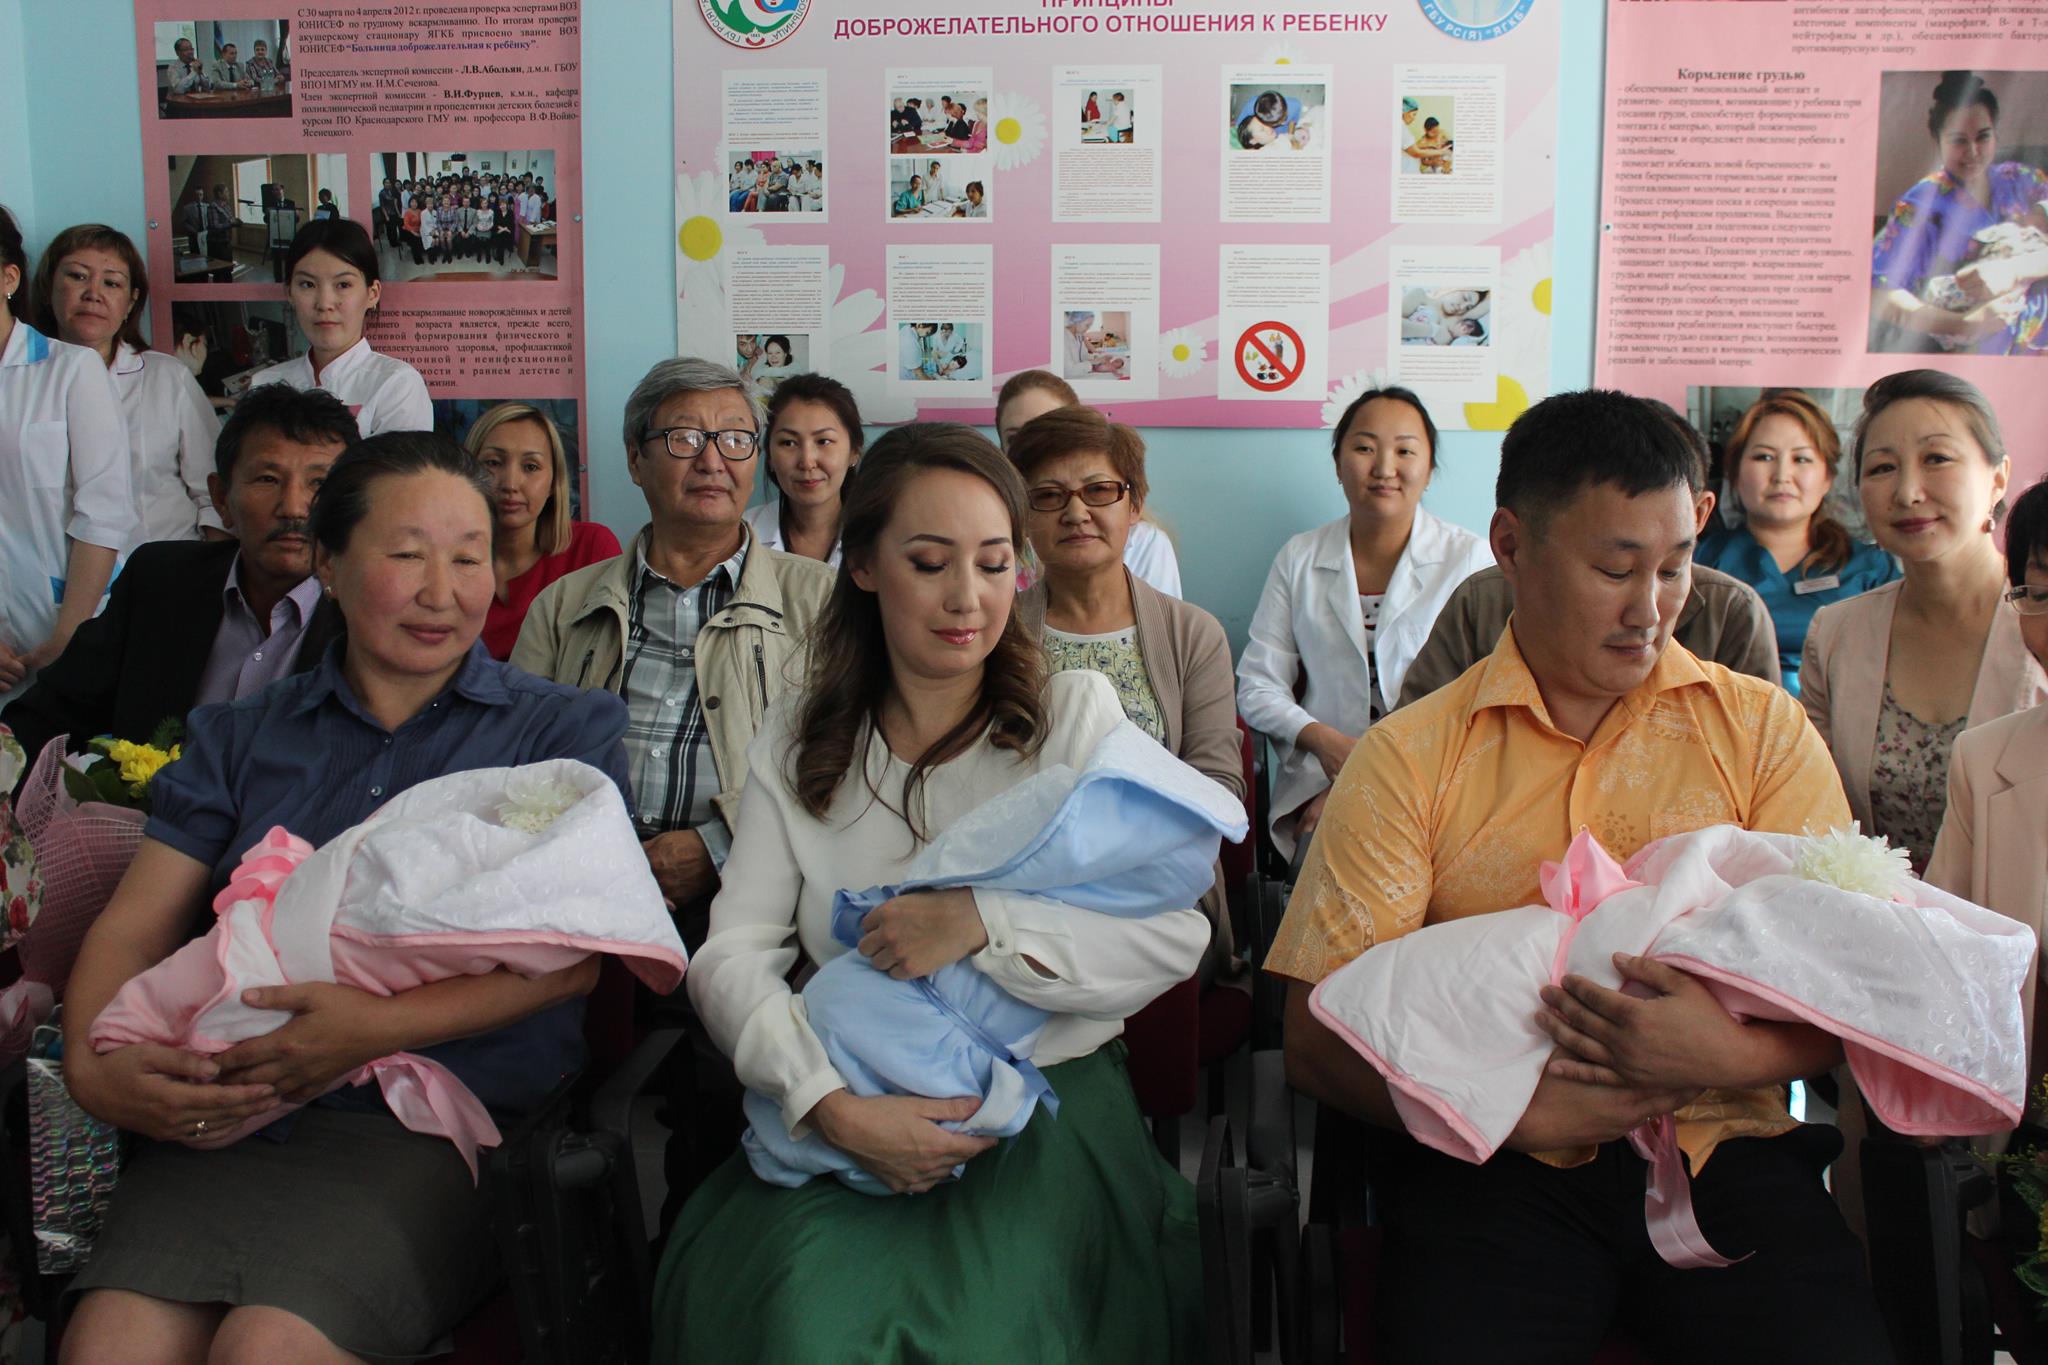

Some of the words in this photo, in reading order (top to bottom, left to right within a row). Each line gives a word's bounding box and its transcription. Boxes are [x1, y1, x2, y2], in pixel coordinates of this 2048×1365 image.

[298, 9, 304, 18] С
[307, 8, 316, 17] 30
[318, 10, 342, 18] марта
[362, 8, 392, 17] апреля
[394, 7, 414, 15] 2012
[423, 6, 468, 16] проведена
[470, 6, 510, 14] проверка
[514, 5, 558, 14] эспертами
[559, 2, 577, 11] ВОЗ
[299, 20, 344, 29] ЮНИСЕФ
[364, 21, 403, 30] грудному
[409, 19, 479, 28] вскармливанию.
[485, 17, 498, 25] По
[538, 16, 577, 26] проверки
[834, 16, 1098, 40] ДОБРОЖЕЛАТЕЛЬНОГО
[1106, 14, 1254, 32] ОТНОШЕНИЯ
[1263, 14, 1276, 31] К
[1283, 14, 1388, 31] РЕБЕНКУ
[299, 34, 358, 43] акушерскому
[366, 32, 419, 41] стационару
[428, 30, 454, 38] ЯГКБ
[462, 30, 512, 39] присвоено
[559, 26, 577, 35] ВОЗ
[300, 44, 345, 53] ЮНИСЕФ
[398, 43, 483, 53] доброжелательная
[1678, 68, 1753, 83] Кормление
[1757, 71, 1805, 83] грудью
[302, 102, 376, 113] поликлинической
[379, 104, 423, 113] педиатрии
[434, 102, 495, 112] пропедевтики
[499, 102, 532, 110] детских
[534, 100, 572, 109] болезней
[302, 117, 332, 127] курсом
[336, 116, 351, 124] ПО
[355, 116, 423, 126] Краснодарского
[428, 114, 449, 123] ГМУ
[474, 114, 525, 124] профессора
[529, 112, 578, 121] В.Ф.Войно-
[366, 310, 400, 318] рудное
[402, 310, 466, 318] вскармливание
[468, 309, 537, 319] новорождённых
[548, 308, 571, 317] детей
[416, 322, 452, 330] возраста
[460, 321, 500, 329] является,
[508, 321, 540, 330] прежде
[547, 321, 572, 329] всего,
[366, 332, 406, 340] основой
[415, 332, 487, 342] формирования
[496, 332, 559, 342] физического
[458, 344, 498, 353] здоровья,
[505, 343, 572, 352] профилактикой
[475, 356, 572, 364] неинфекционной
[473, 368, 511, 376] раннем
